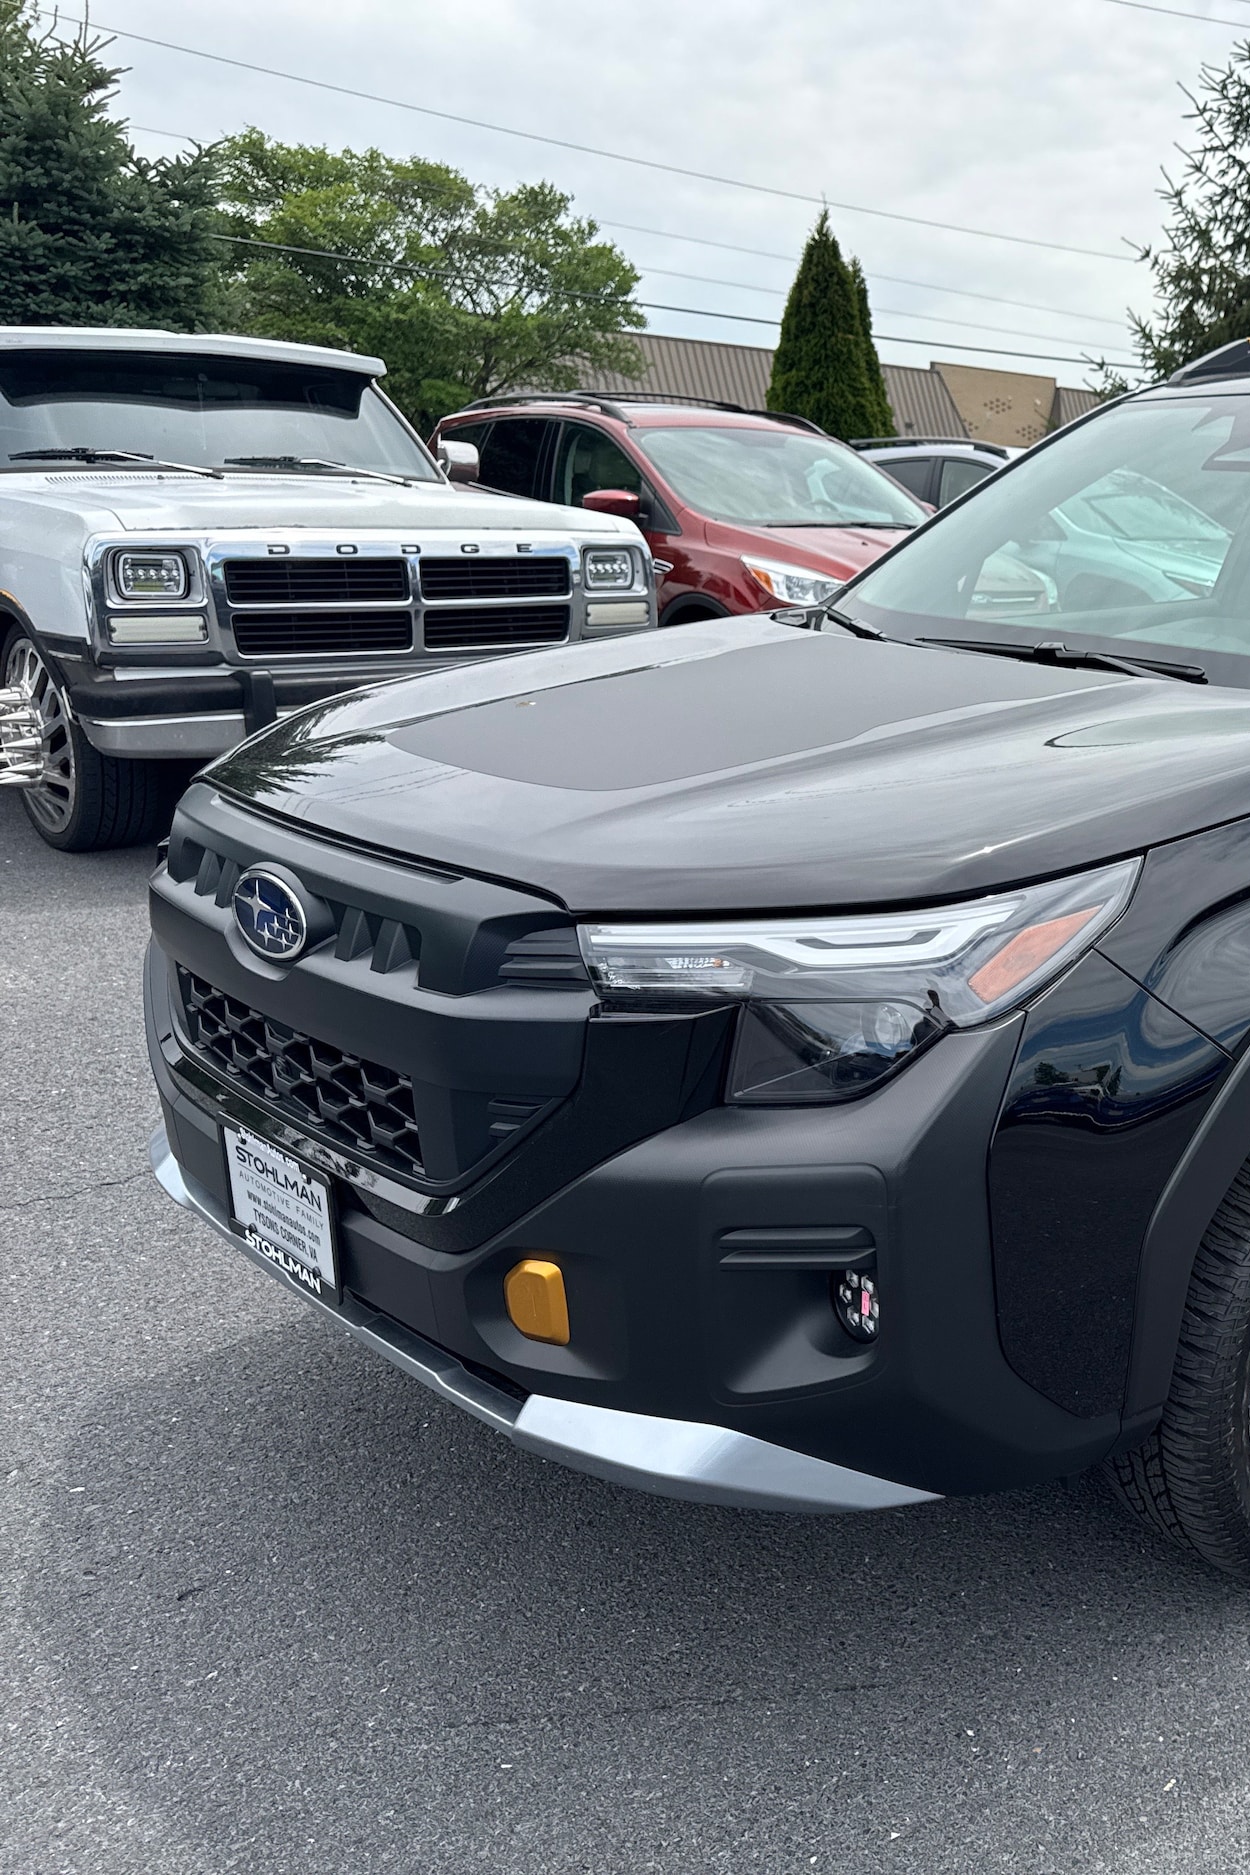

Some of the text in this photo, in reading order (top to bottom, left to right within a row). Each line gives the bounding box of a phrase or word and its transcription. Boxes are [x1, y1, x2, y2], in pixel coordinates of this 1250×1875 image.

[267, 543, 533, 555] DODGE
[235, 1145, 322, 1212] STOHLMAN
[239, 1170, 324, 1231] AUTOMOTIVE FAMILY
[245, 1229, 321, 1295] STOHLMAN
[253, 1208, 280, 1236] TYSONS
[309, 1244, 319, 1263] VA
